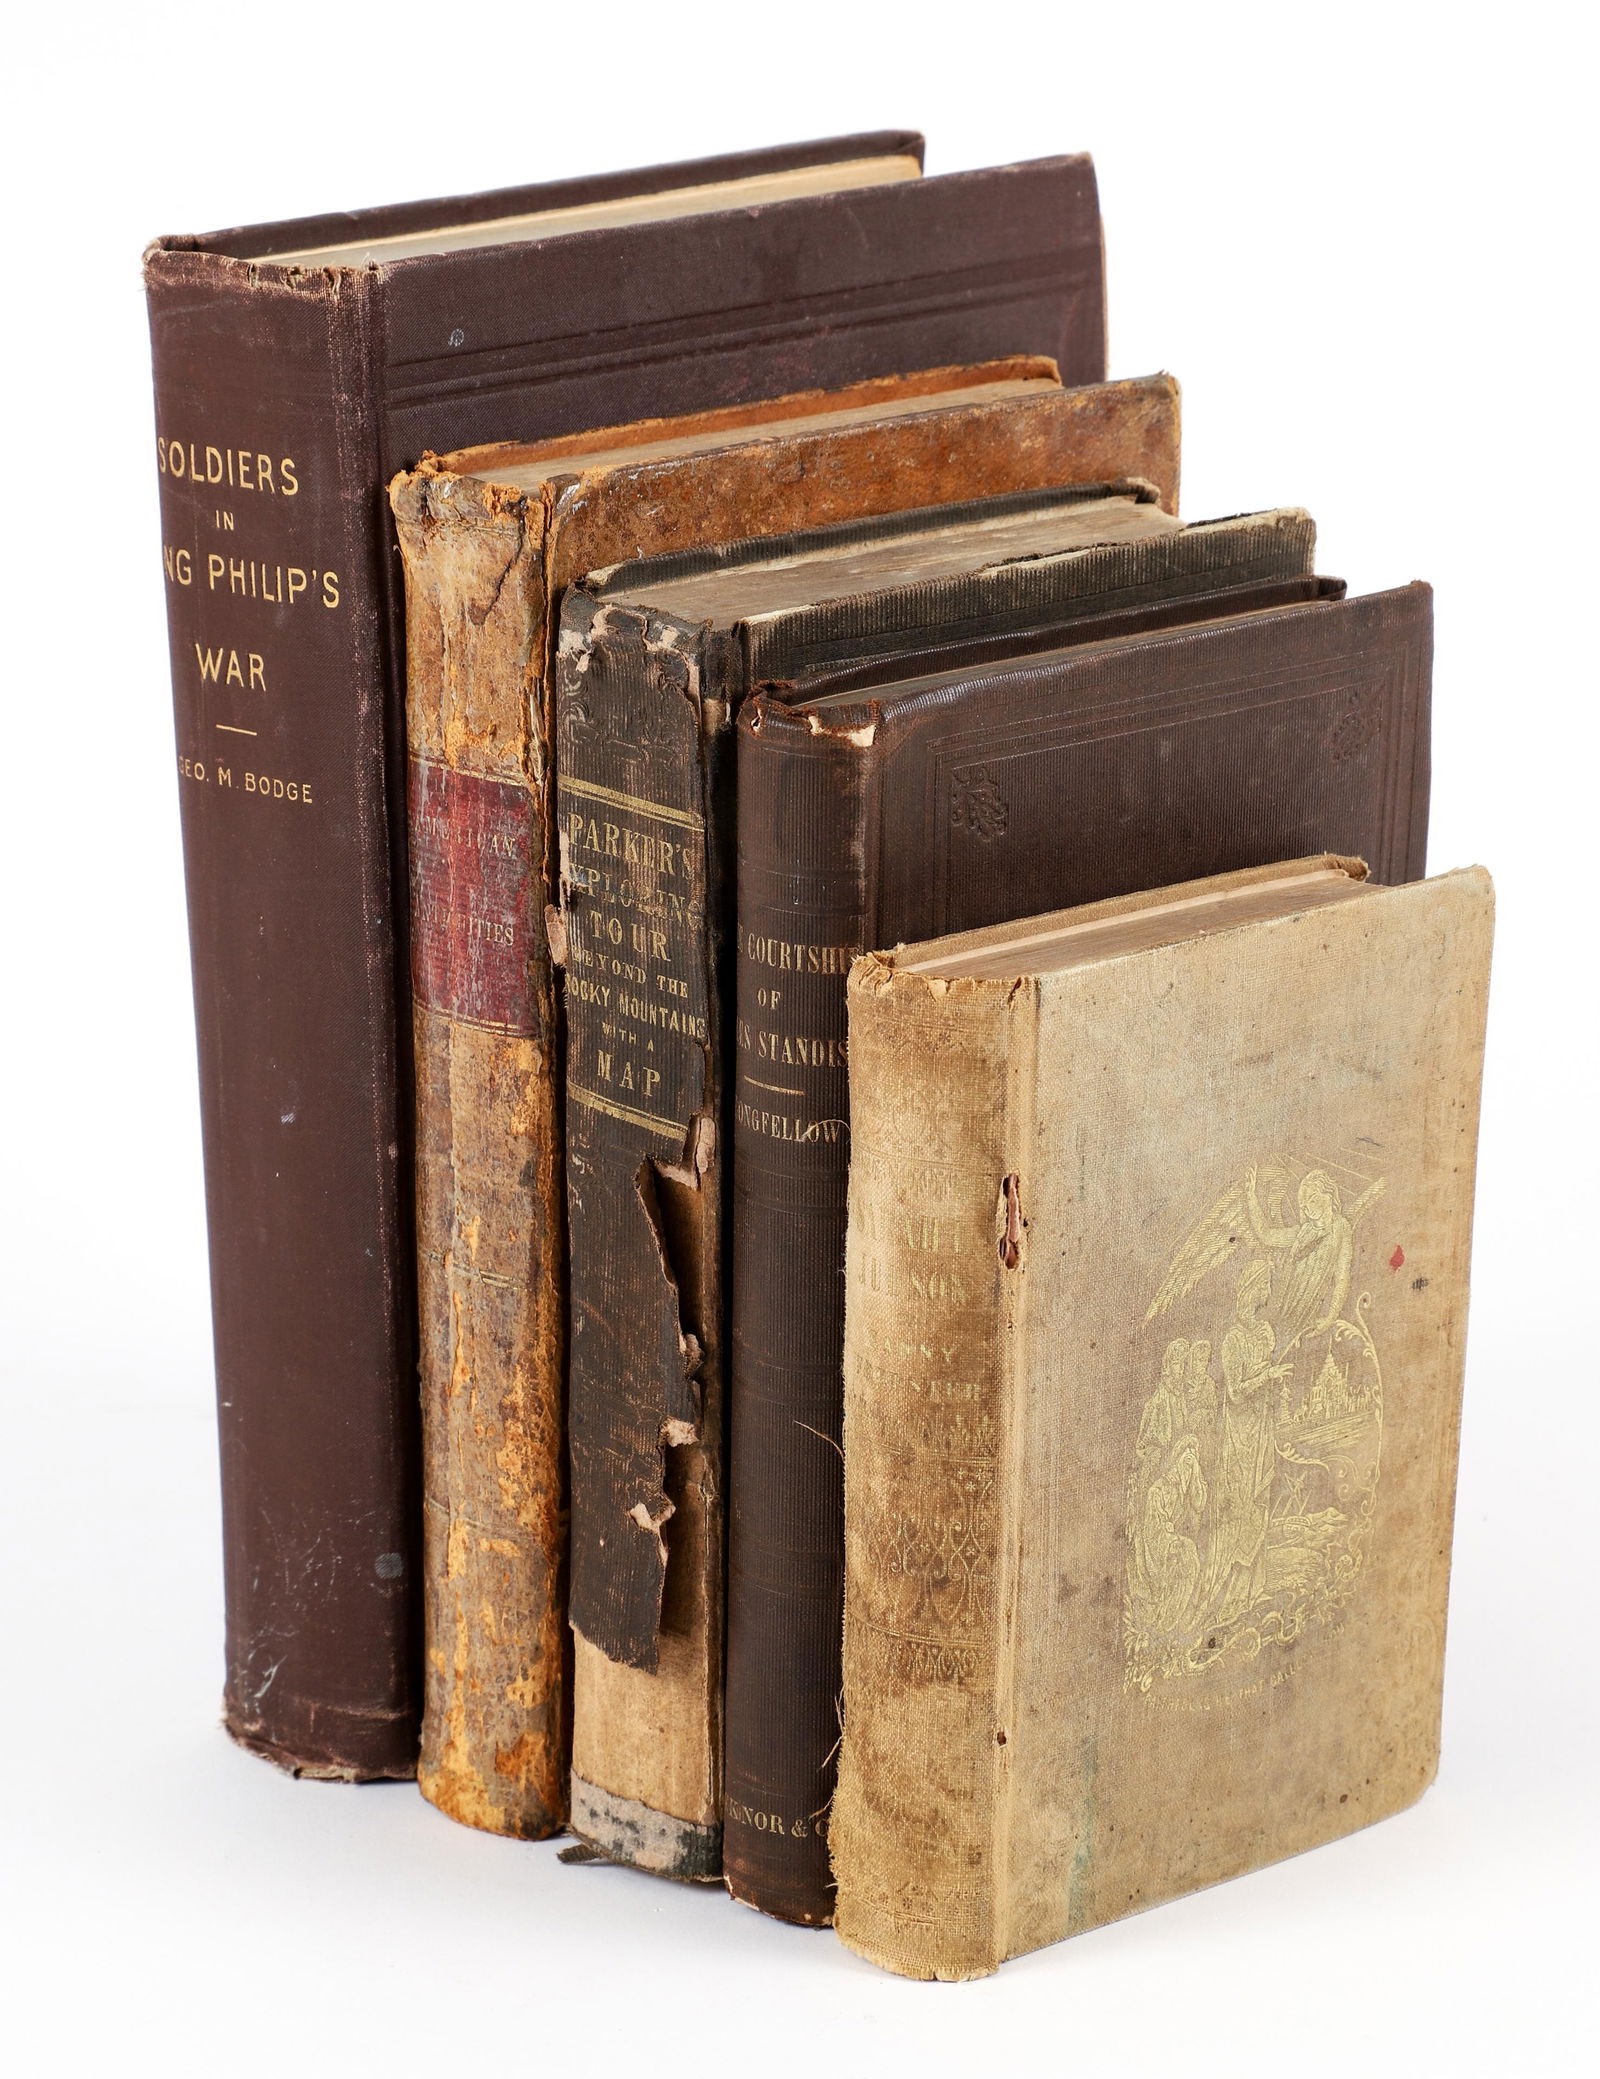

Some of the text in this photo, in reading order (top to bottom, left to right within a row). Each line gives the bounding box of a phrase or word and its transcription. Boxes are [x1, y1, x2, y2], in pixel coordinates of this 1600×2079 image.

[158, 437, 299, 496] SOLDIERS
[215, 510, 234, 531] IN
[208, 553, 340, 609] PHILIP'S
[194, 643, 267, 692] WAR
[245, 772, 313, 803] BODGE
[568, 811, 694, 880] PARKER'S
[590, 909, 671, 962] TOUR
[656, 974, 689, 998] THE
[757, 988, 780, 1010] OF
[602, 1021, 636, 1045] WITH
[597, 1049, 661, 1097] MAP
